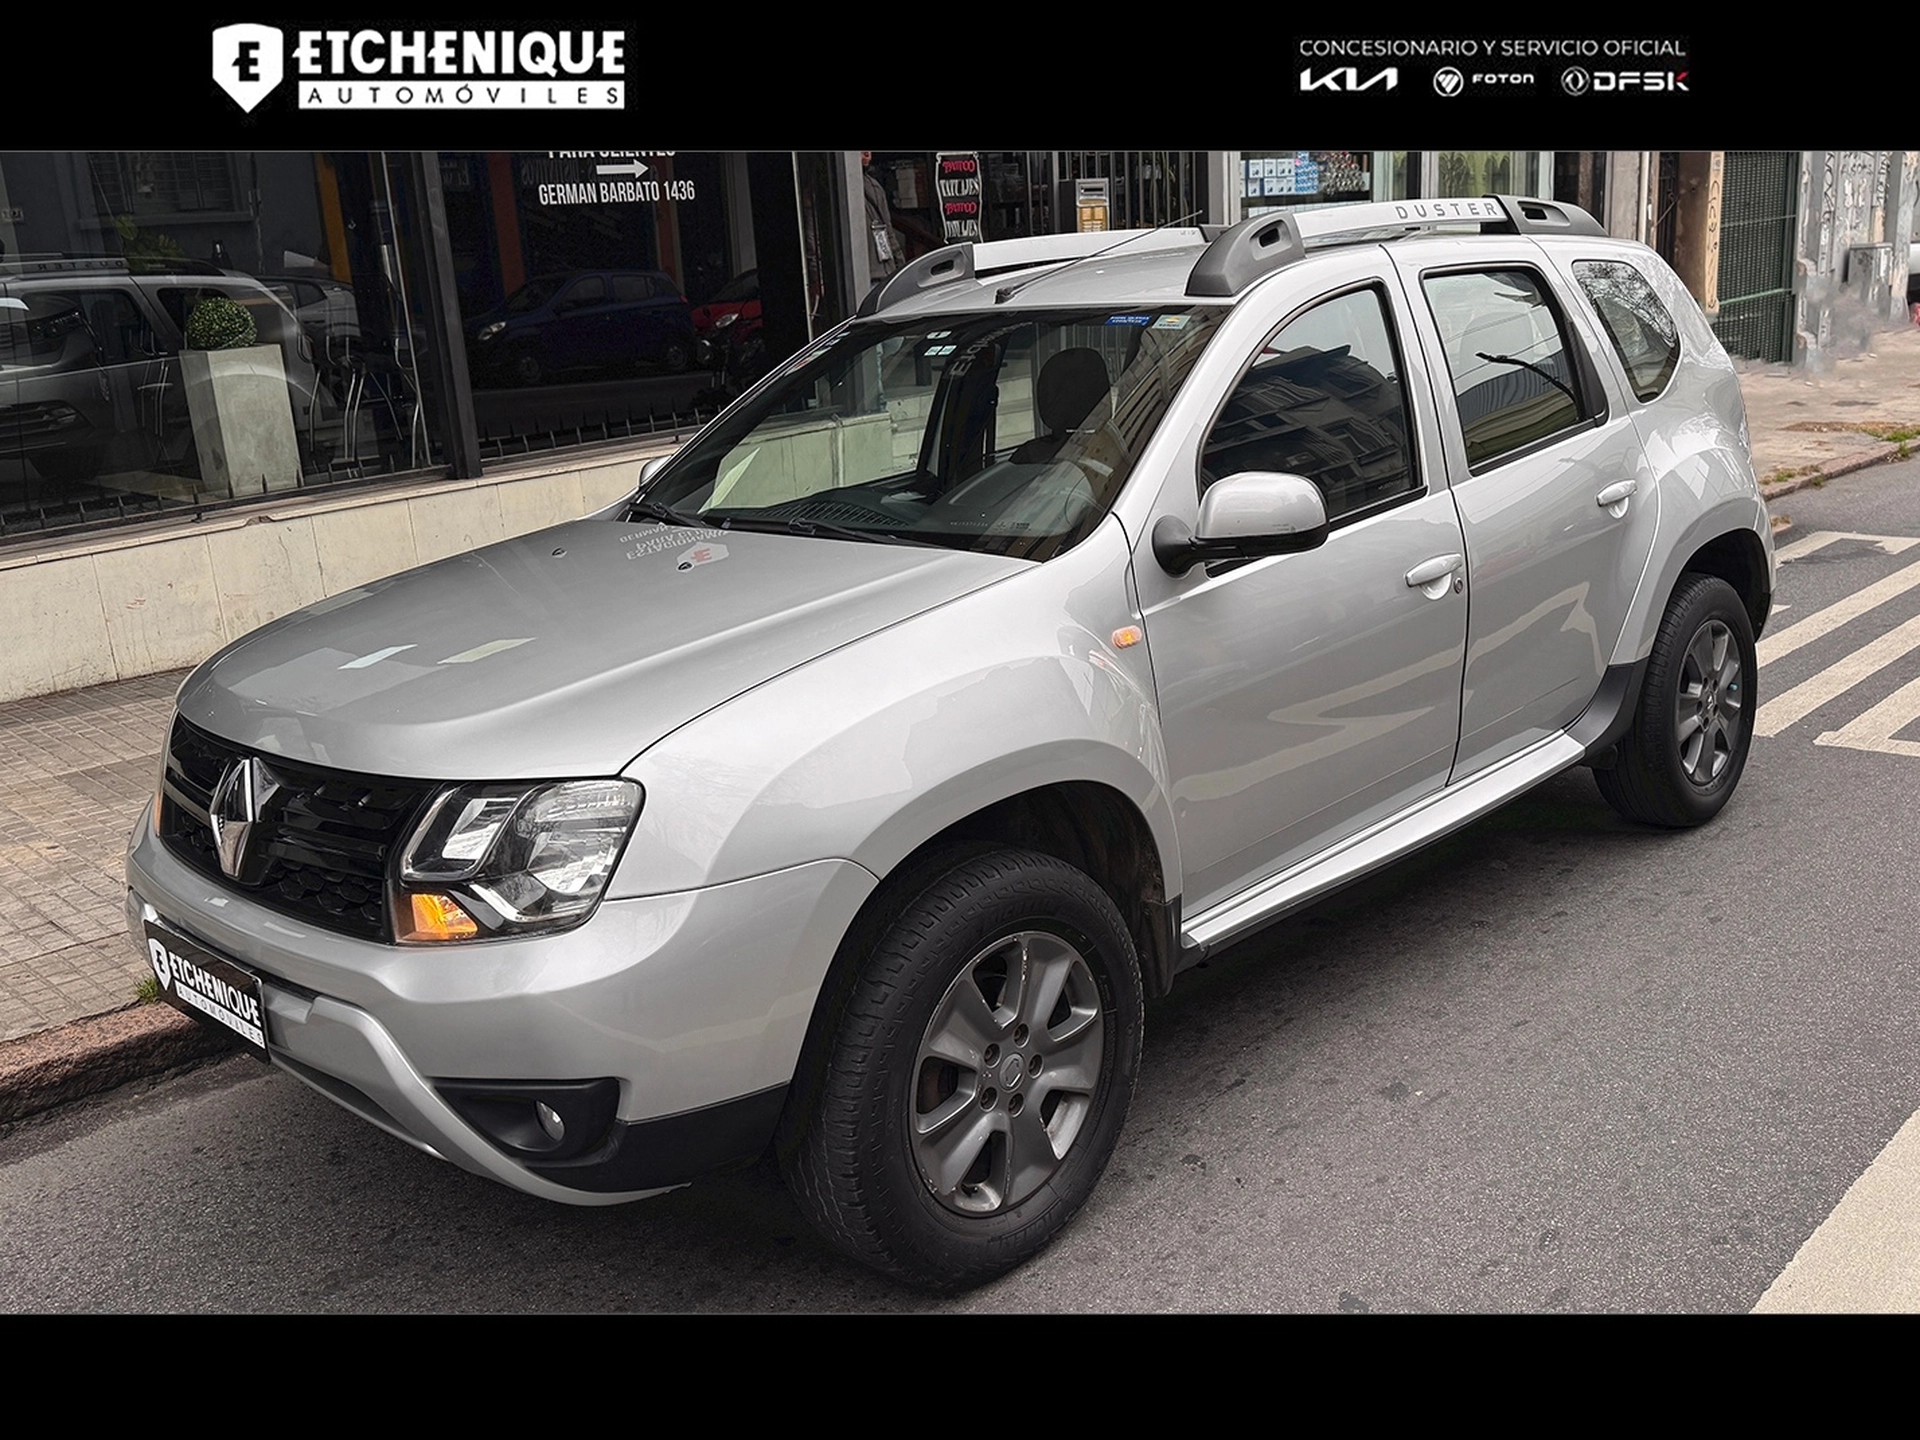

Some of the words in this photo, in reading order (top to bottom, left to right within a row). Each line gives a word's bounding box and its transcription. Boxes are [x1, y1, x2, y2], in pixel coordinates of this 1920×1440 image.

[538, 182, 598, 206] GERMAN
[600, 181, 660, 203] BARBATO
[663, 180, 696, 201] 1436
[1395, 202, 1498, 219] DUSTER
[168, 951, 262, 1027] ETCHENIQUE
